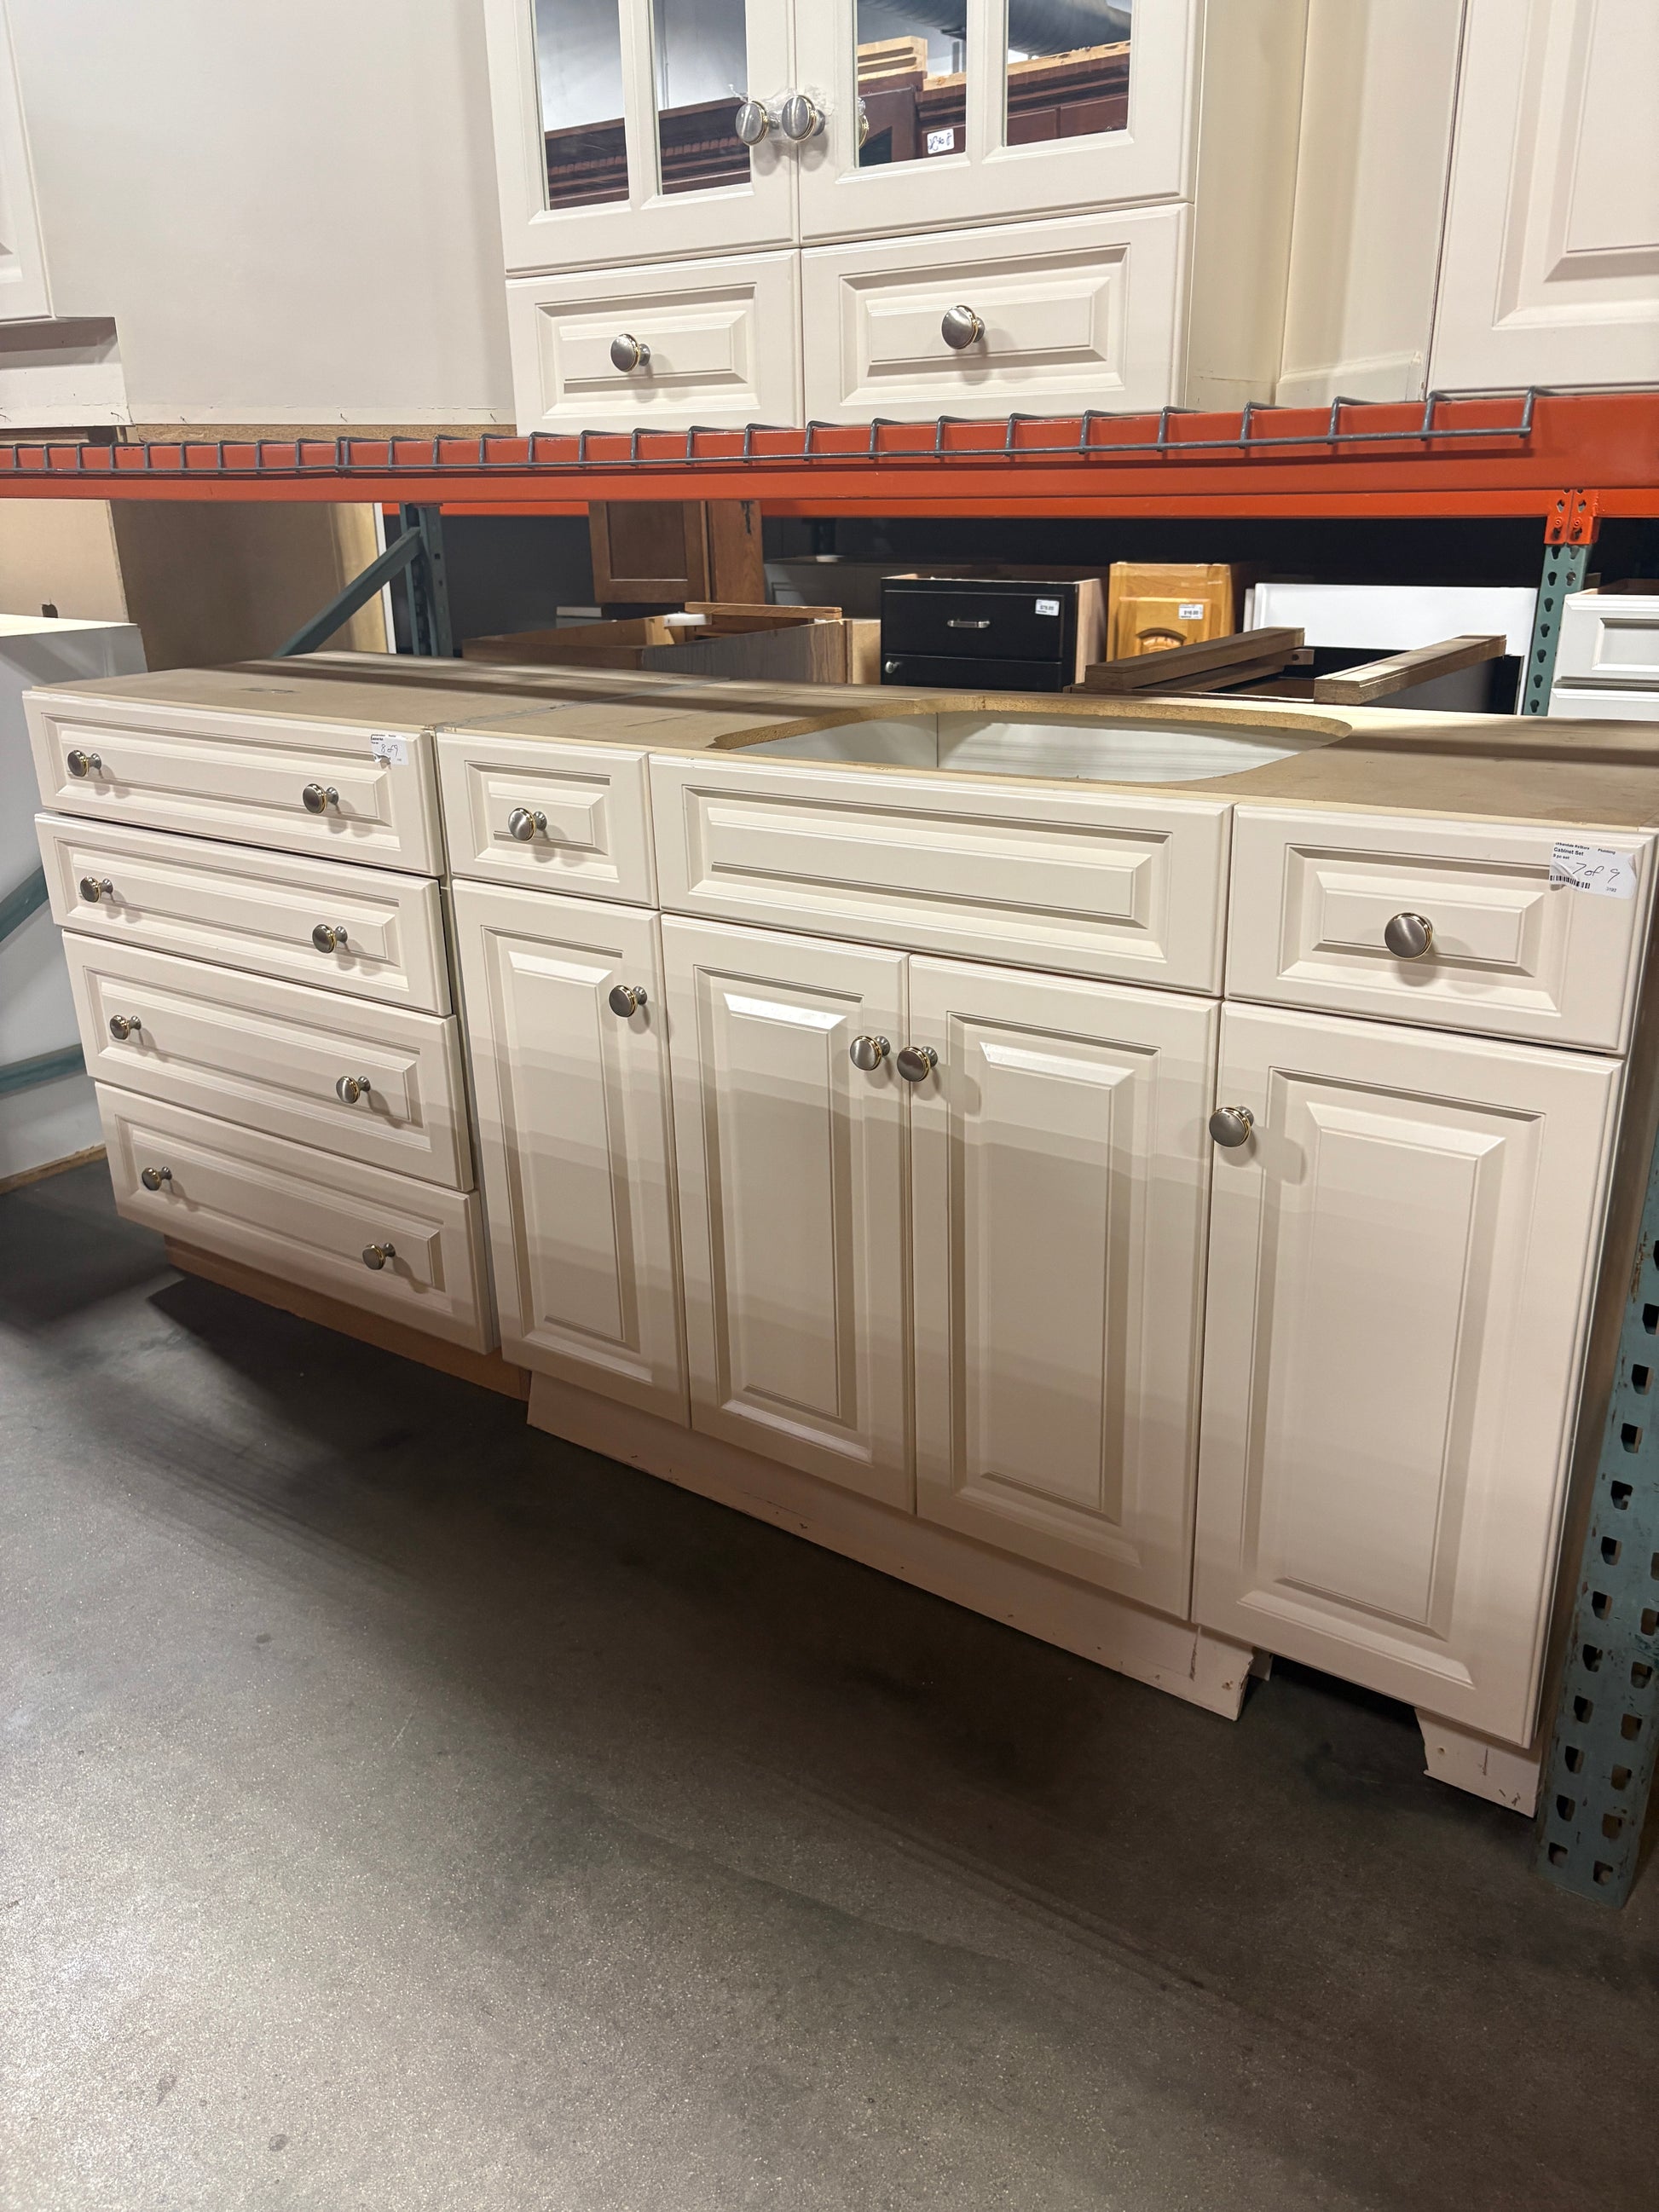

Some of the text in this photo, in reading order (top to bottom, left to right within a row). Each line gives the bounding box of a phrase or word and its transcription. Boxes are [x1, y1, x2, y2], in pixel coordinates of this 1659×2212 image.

[381, 743, 386, 753] 8
[393, 744, 398, 757] 9
[1572, 862, 1621, 884] 7 of 9
